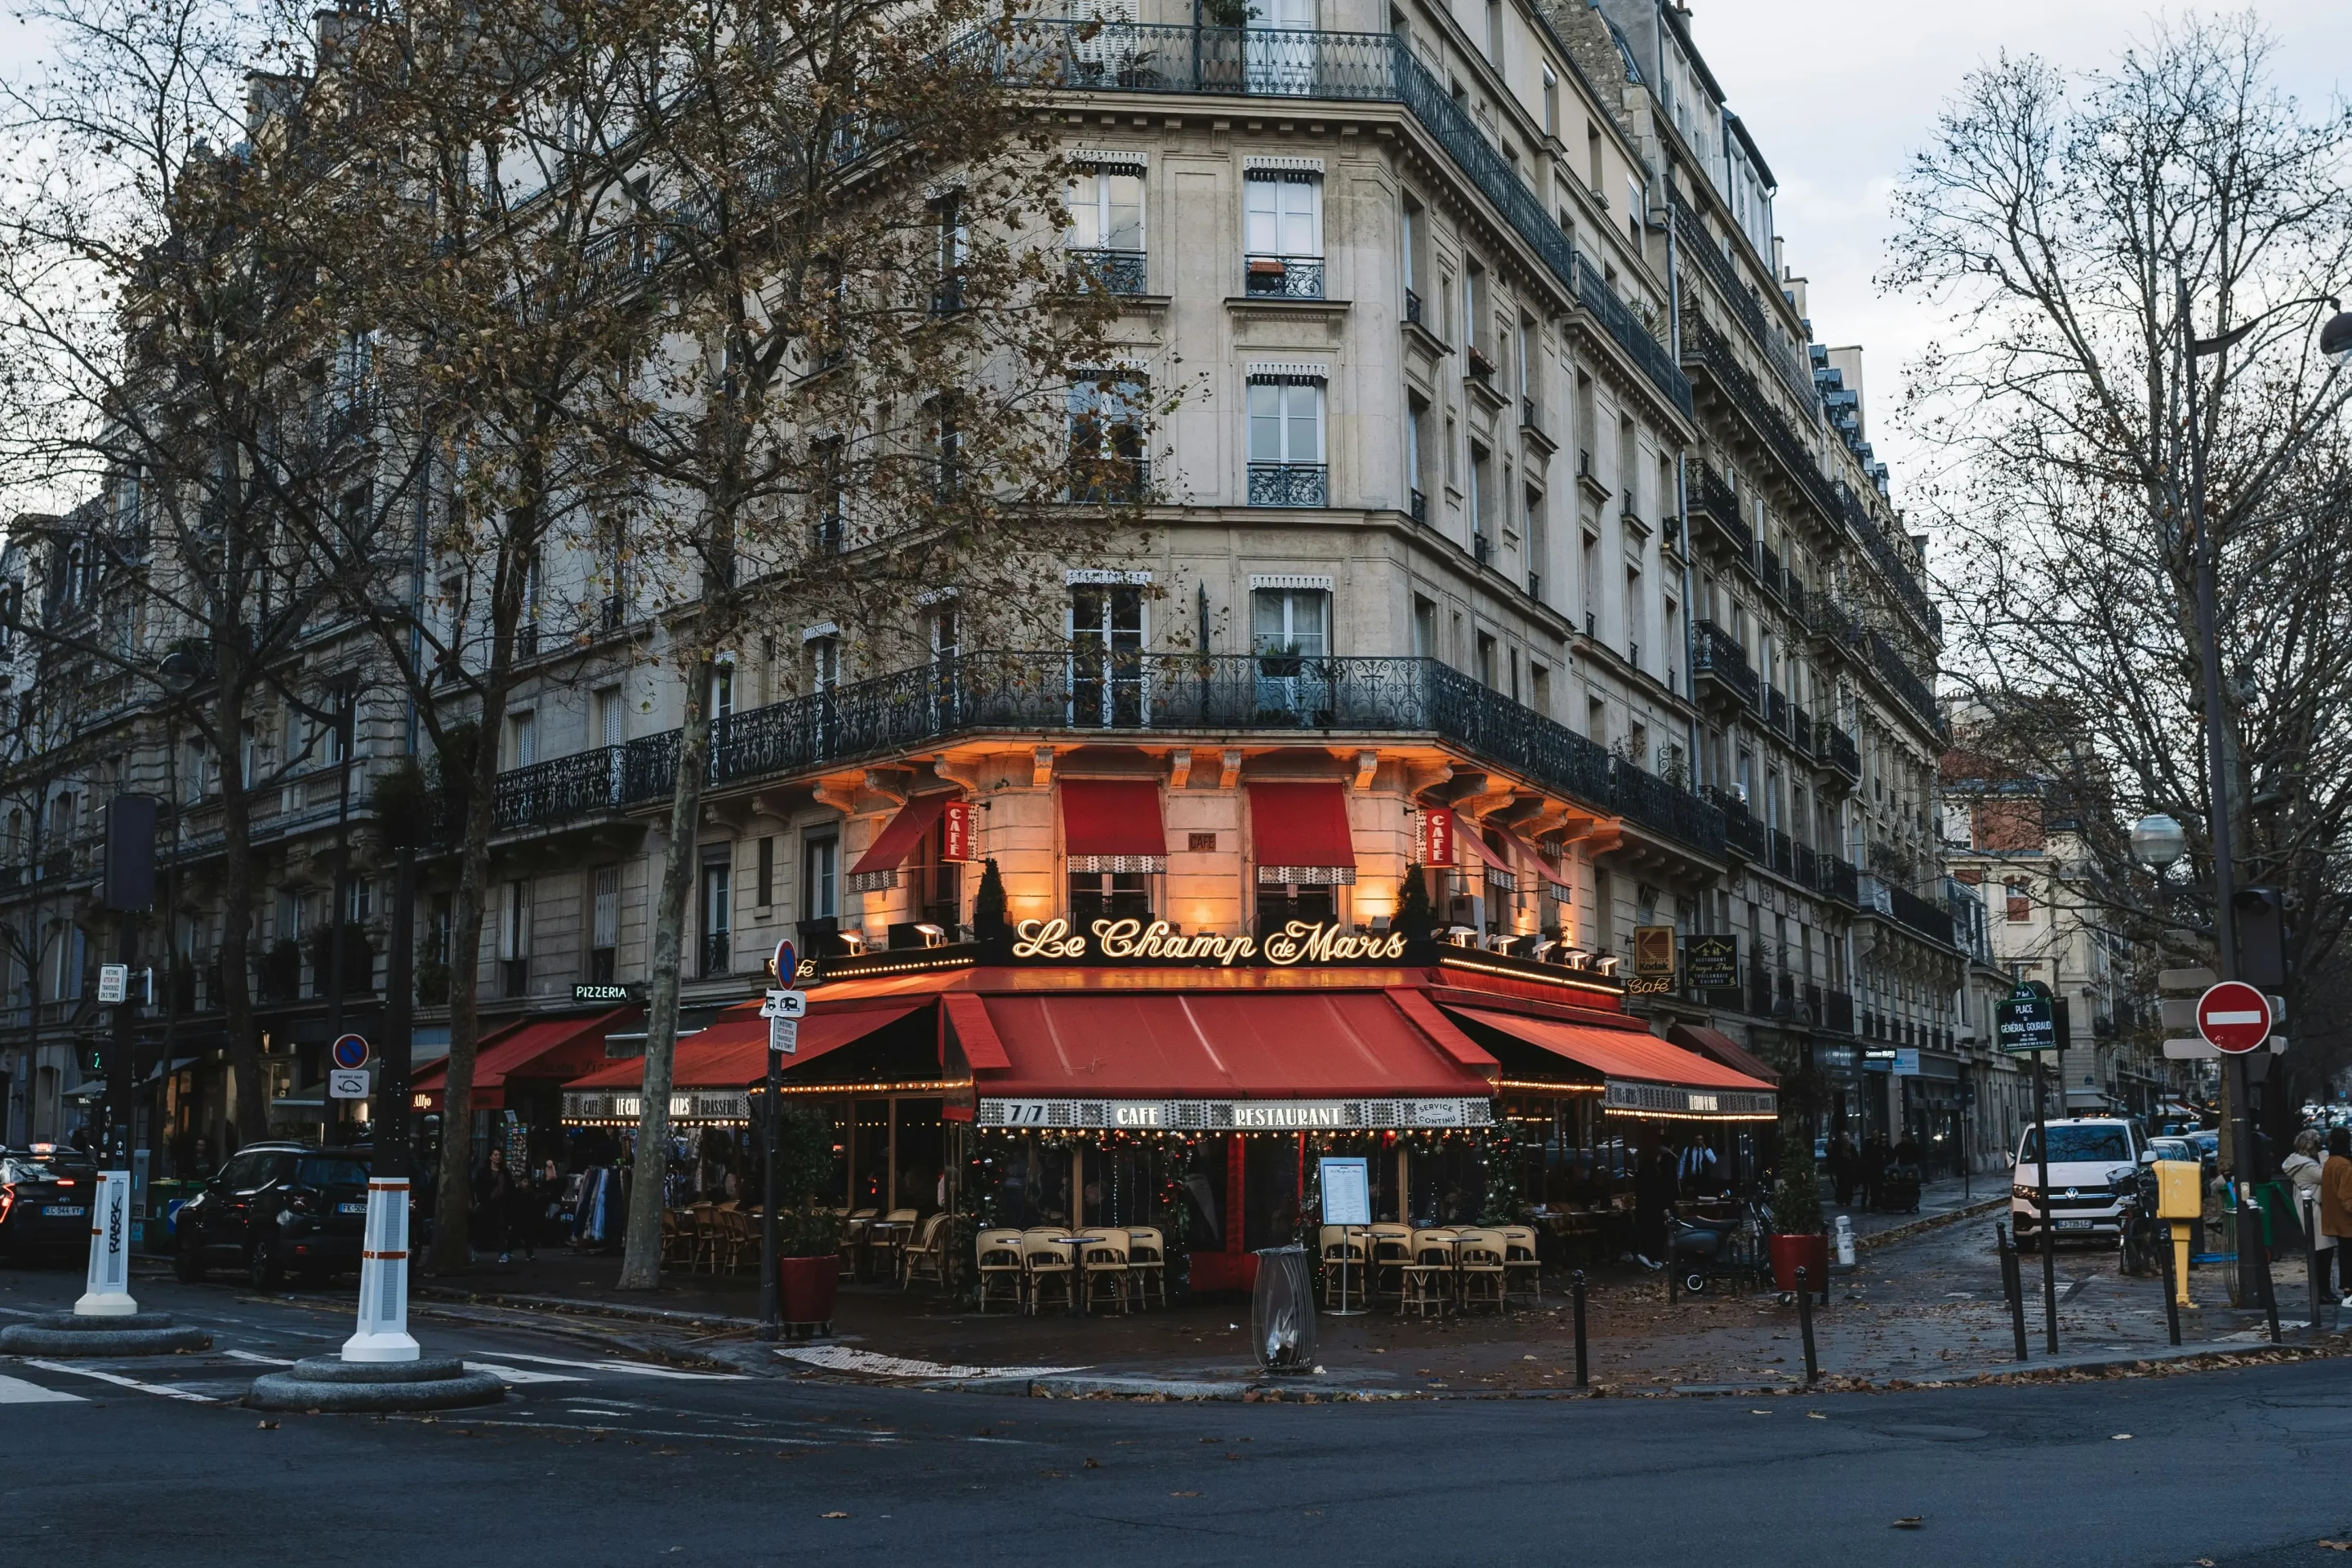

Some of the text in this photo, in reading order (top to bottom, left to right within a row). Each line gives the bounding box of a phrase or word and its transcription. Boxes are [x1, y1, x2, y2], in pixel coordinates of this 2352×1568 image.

[950, 808, 962, 856] CAFE
[1431, 814, 1445, 862] CAFE
[1190, 834, 1215, 849] CAFE
[1012, 917, 1408, 965] Le Champ de Mars
[1639, 962, 1669, 971] Kodak
[1715, 963, 1735, 971] Thai
[576, 986, 627, 998] PIZZERIA
[2015, 1004, 2034, 1014] PLACE
[2000, 1021, 2051, 1033] GÉNÉRAL GOURAUD
[584, 1099, 599, 1115] CAFE
[617, 1098, 626, 1116] LE
[701, 1099, 739, 1116] BRASSERIE
[1009, 1104, 1044, 1124] 7/7
[1419, 1102, 1454, 1113] SERVICE
[1116, 1107, 1160, 1126] CAFE
[1235, 1107, 1341, 1127] RESTAURANT
[1419, 1116, 1456, 1125] CONTINU
